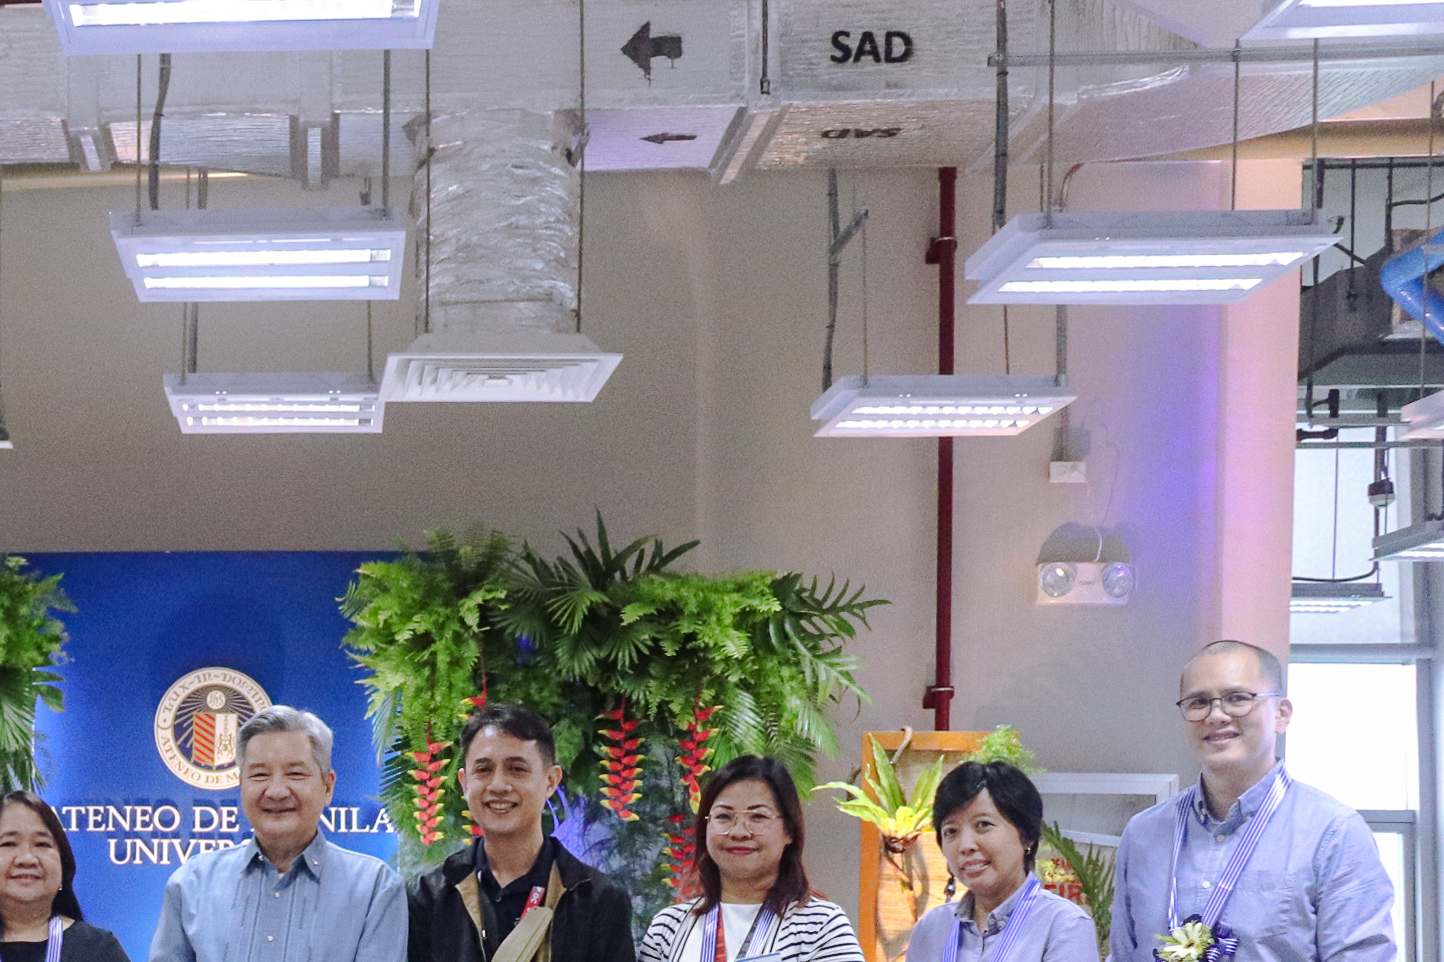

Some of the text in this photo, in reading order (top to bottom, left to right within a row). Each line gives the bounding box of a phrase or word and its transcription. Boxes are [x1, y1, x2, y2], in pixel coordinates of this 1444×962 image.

[830, 30, 914, 63] SAD
[221, 672, 268, 711] DOMIN
[160, 736, 202, 782] ATENEO
[192, 805, 240, 832] DE
